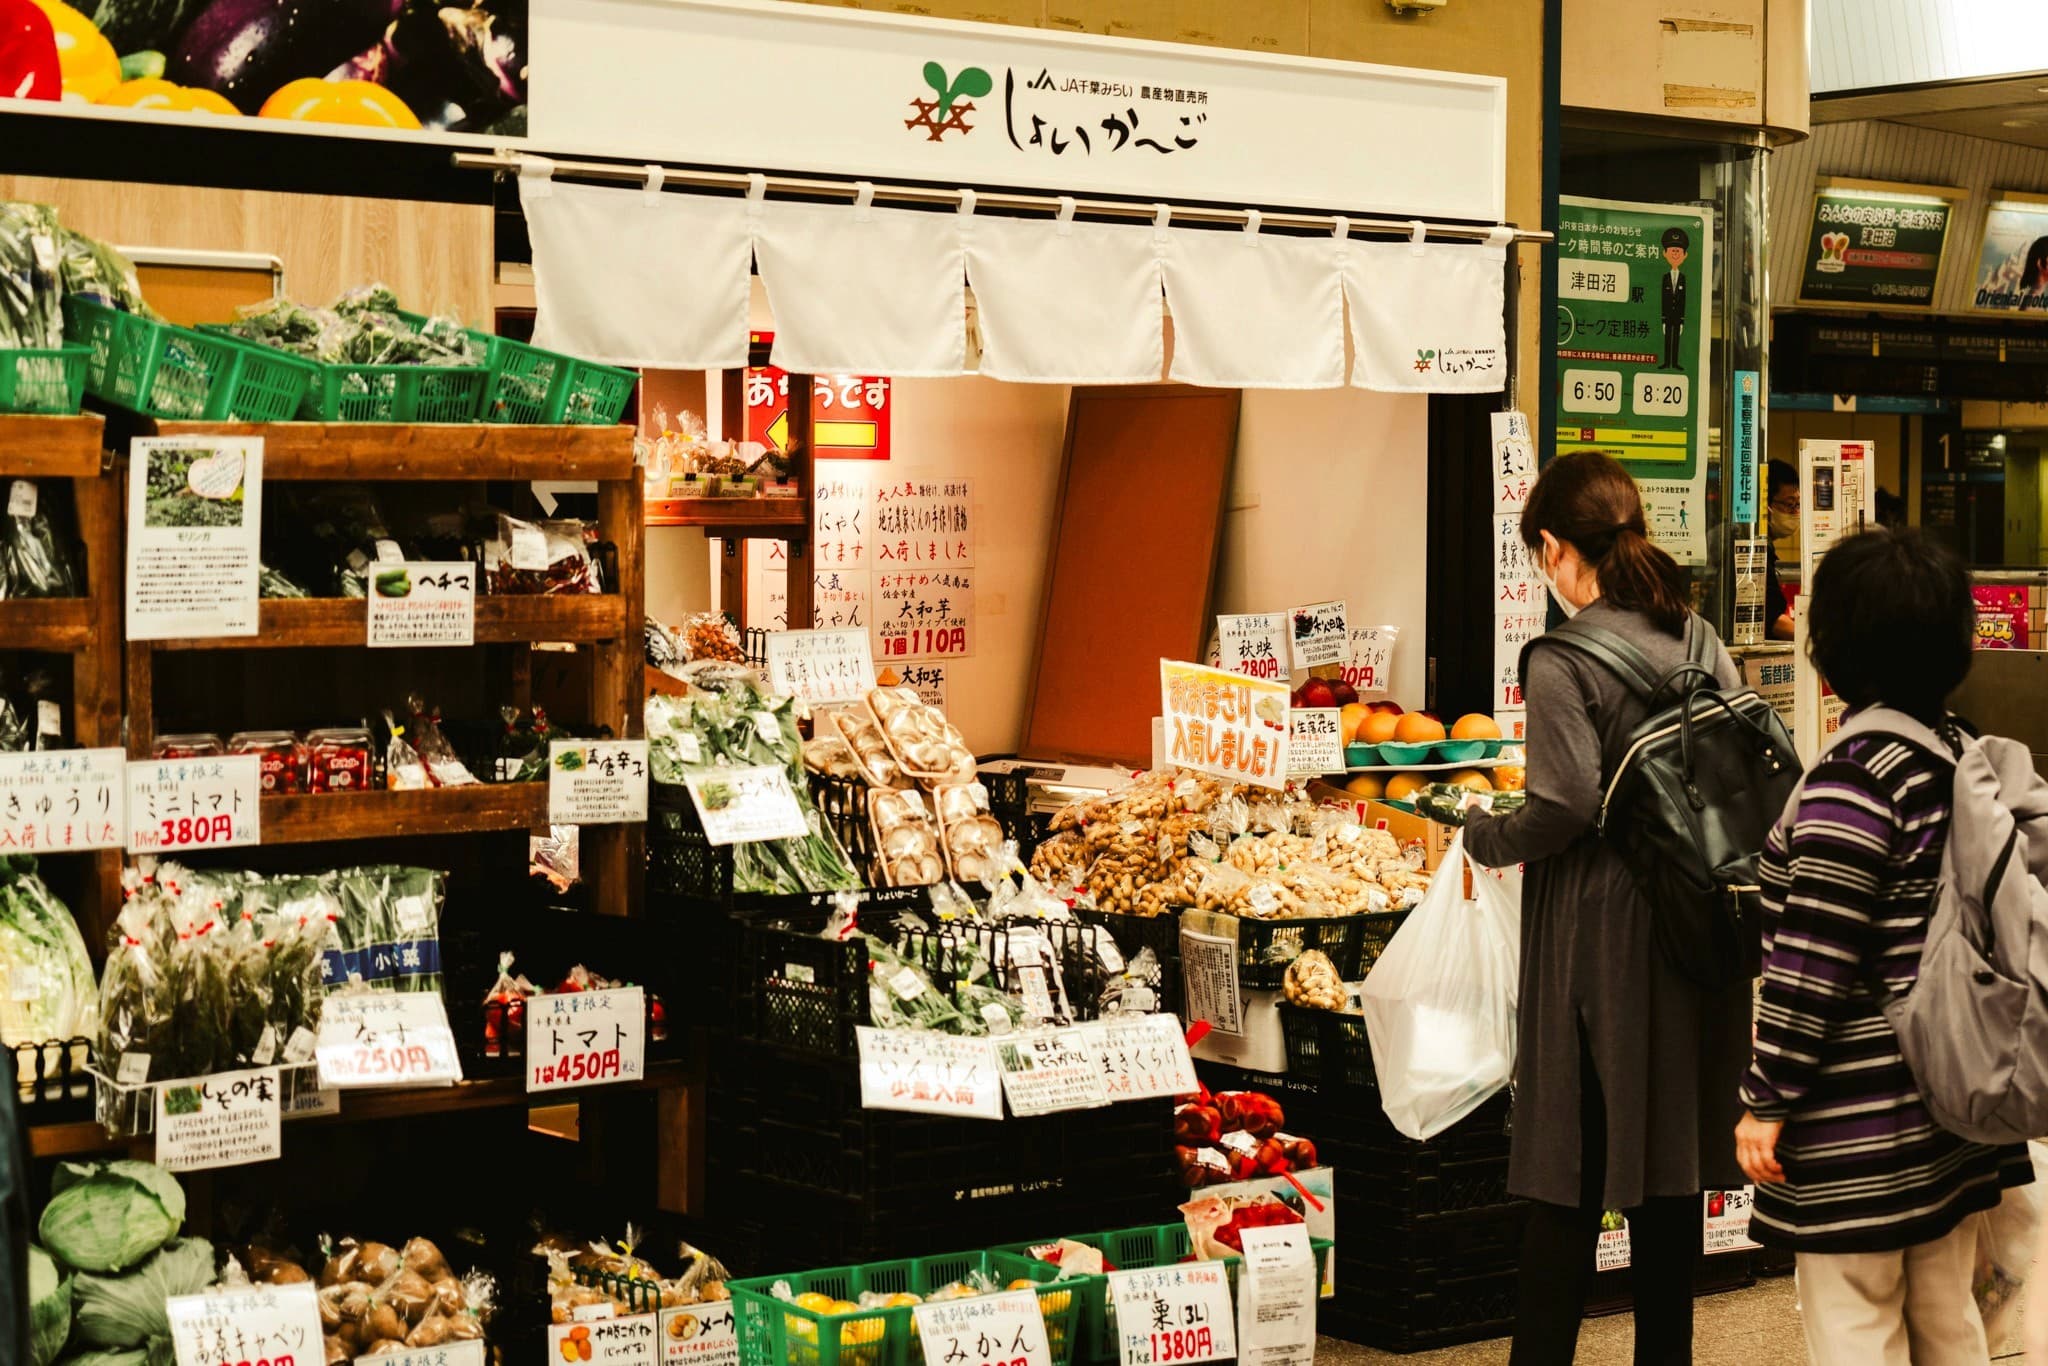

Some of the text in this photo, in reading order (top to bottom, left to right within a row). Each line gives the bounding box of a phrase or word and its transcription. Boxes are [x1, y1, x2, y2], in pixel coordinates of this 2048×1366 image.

[1060, 78, 1133, 98] JA千葉みらい
[1141, 86, 1208, 105] 農産物直売所
[1559, 221, 1642, 237] JR東日本からのお知らせ
[1861, 228, 1896, 247] 津田沼
[1571, 271, 1616, 293] 津田沼
[1632, 286, 1645, 304] 駅
[1574, 382, 1682, 404] 6:50 8:20
[877, 482, 917, 503] 大人気
[879, 540, 967, 562] 入荷しました
[419, 572, 470, 591] ヘチマ
[880, 574, 970, 589] おすすめ 人気商品
[898, 598, 951, 619] 大和芋
[884, 637, 907, 655] 1個
[912, 627, 966, 655] 110円
[1239, 637, 1273, 659] 秋映
[901, 665, 944, 688] 大和芋
[1242, 658, 1279, 679] 780円
[1168, 675, 1251, 728] おおまさり
[1297, 720, 1336, 734] 生落花生
[1171, 716, 1279, 777] 入荷しました！
[6, 786, 110, 820] きゅうり
[148, 788, 241, 818] ミニトマト
[0, 821, 115, 848] 入荷しました
[161, 814, 232, 845] 380円
[375, 948, 421, 971] 小菜
[355, 1023, 412, 1048] なす
[552, 1023, 628, 1056] トマト
[355, 1045, 431, 1074] 250円
[556, 1049, 620, 1082] 450円
[1038, 1052, 1087, 1067] とうがらし
[1102, 1042, 1177, 1073] 生きくらげ
[202, 1075, 274, 1110] しその実
[891, 1080, 974, 1105] 少量入荷
[1107, 1071, 1187, 1093] 入荷しました
[944, 1325, 1036, 1363] みかん
[1151, 1327, 1212, 1362] 1380円
